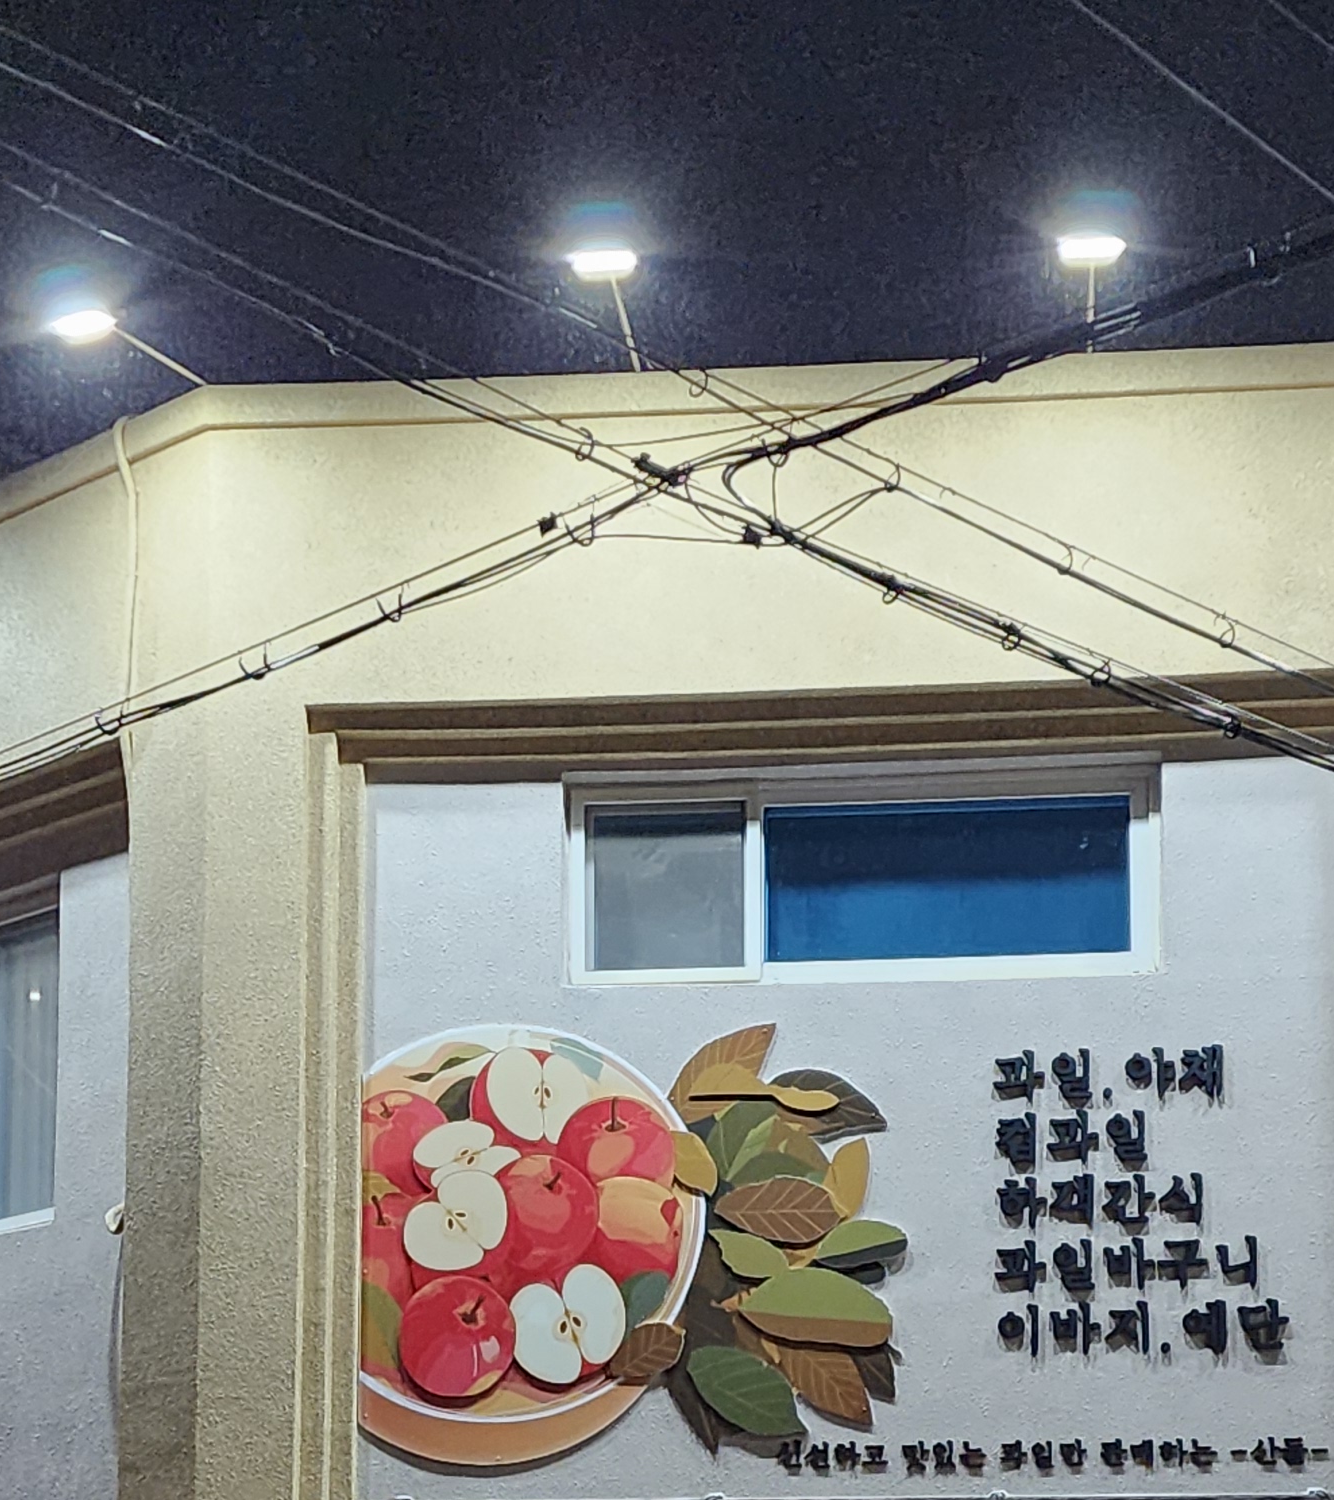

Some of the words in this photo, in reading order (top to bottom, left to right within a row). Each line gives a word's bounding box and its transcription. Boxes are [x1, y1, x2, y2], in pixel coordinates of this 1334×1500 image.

[995, 1109, 1149, 1171] 컵과일
[996, 1172, 1204, 1233] 하객간식
[993, 1235, 1258, 1300] 과일바구니
[777, 1439, 888, 1474] 신선하고
[901, 1440, 987, 1475] 맛있는
[1000, 1439, 1087, 1474] 과일만
[1100, 1438, 1218, 1474] 판매하는
